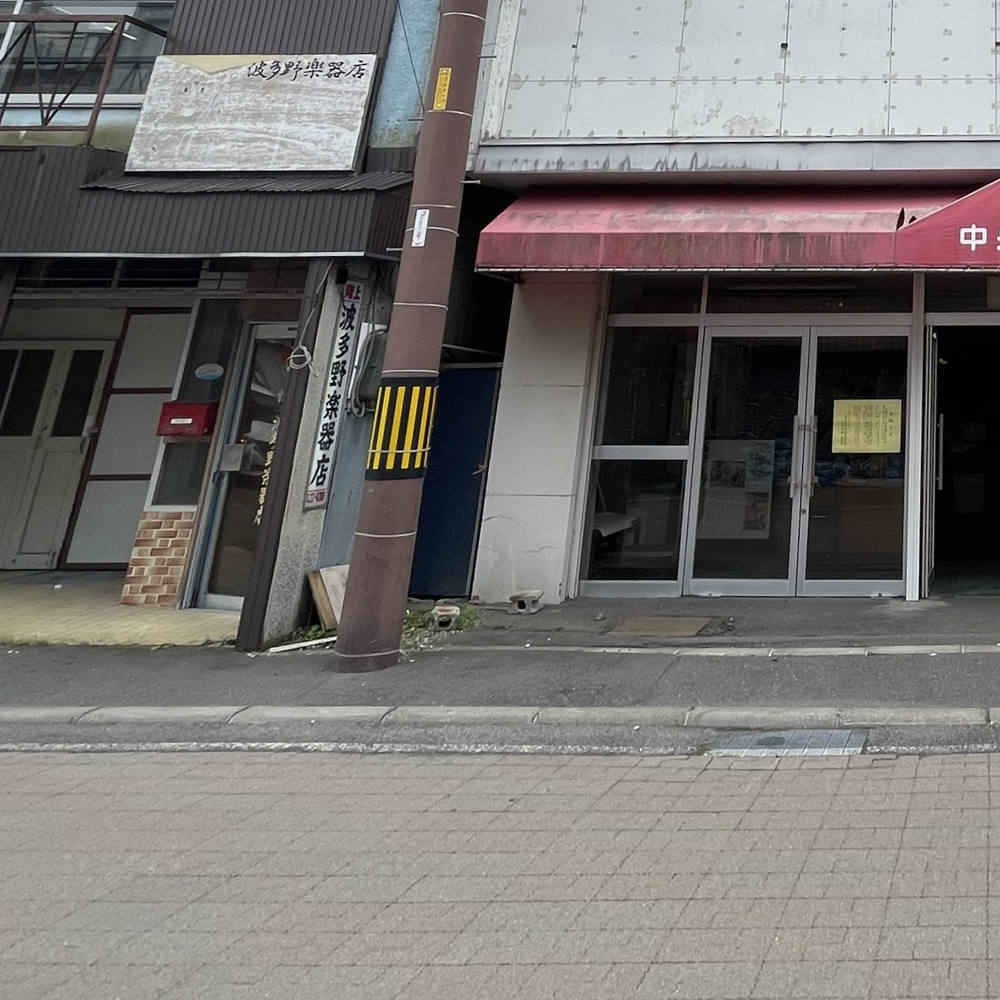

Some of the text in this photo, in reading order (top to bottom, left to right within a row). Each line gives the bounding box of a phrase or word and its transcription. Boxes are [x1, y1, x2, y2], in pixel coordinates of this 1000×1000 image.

[247, 58, 369, 82] 波多野楽器店
[309, 303, 357, 487] 波多野楽器店
